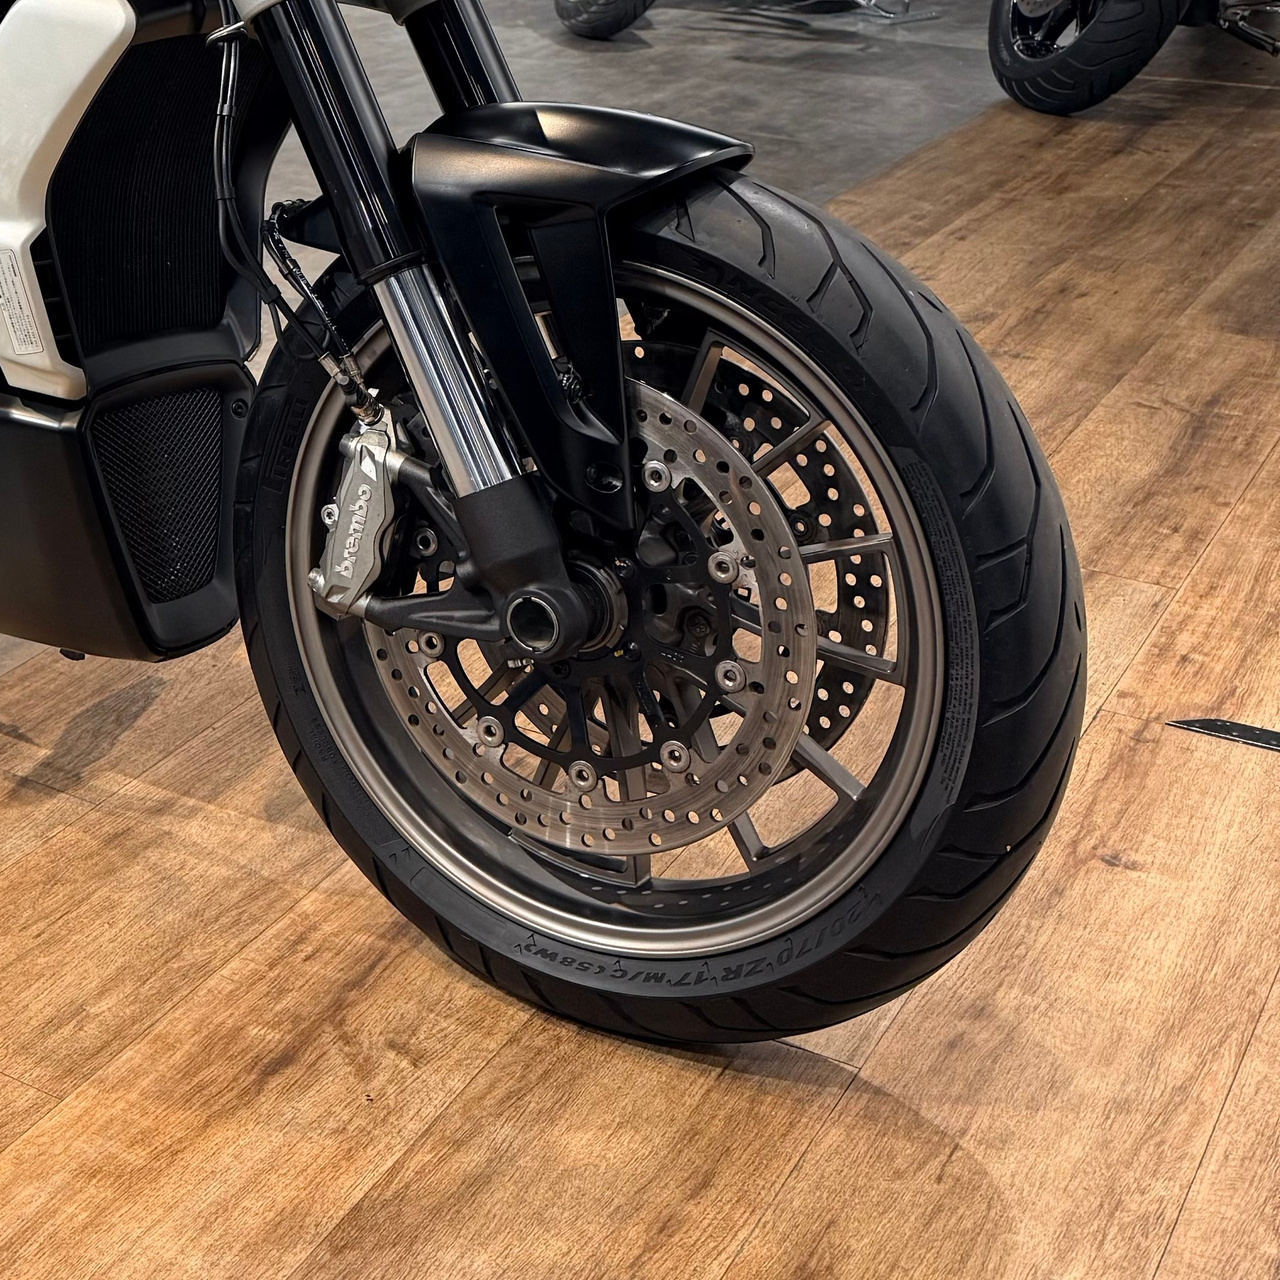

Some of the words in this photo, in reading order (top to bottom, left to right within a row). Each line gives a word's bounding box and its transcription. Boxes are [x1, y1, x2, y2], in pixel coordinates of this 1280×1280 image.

[334, 483, 373, 580] brembo
[777, 896, 868, 966] 20/70
[670, 970, 708, 987] 17
[721, 956, 768, 983] ZR
